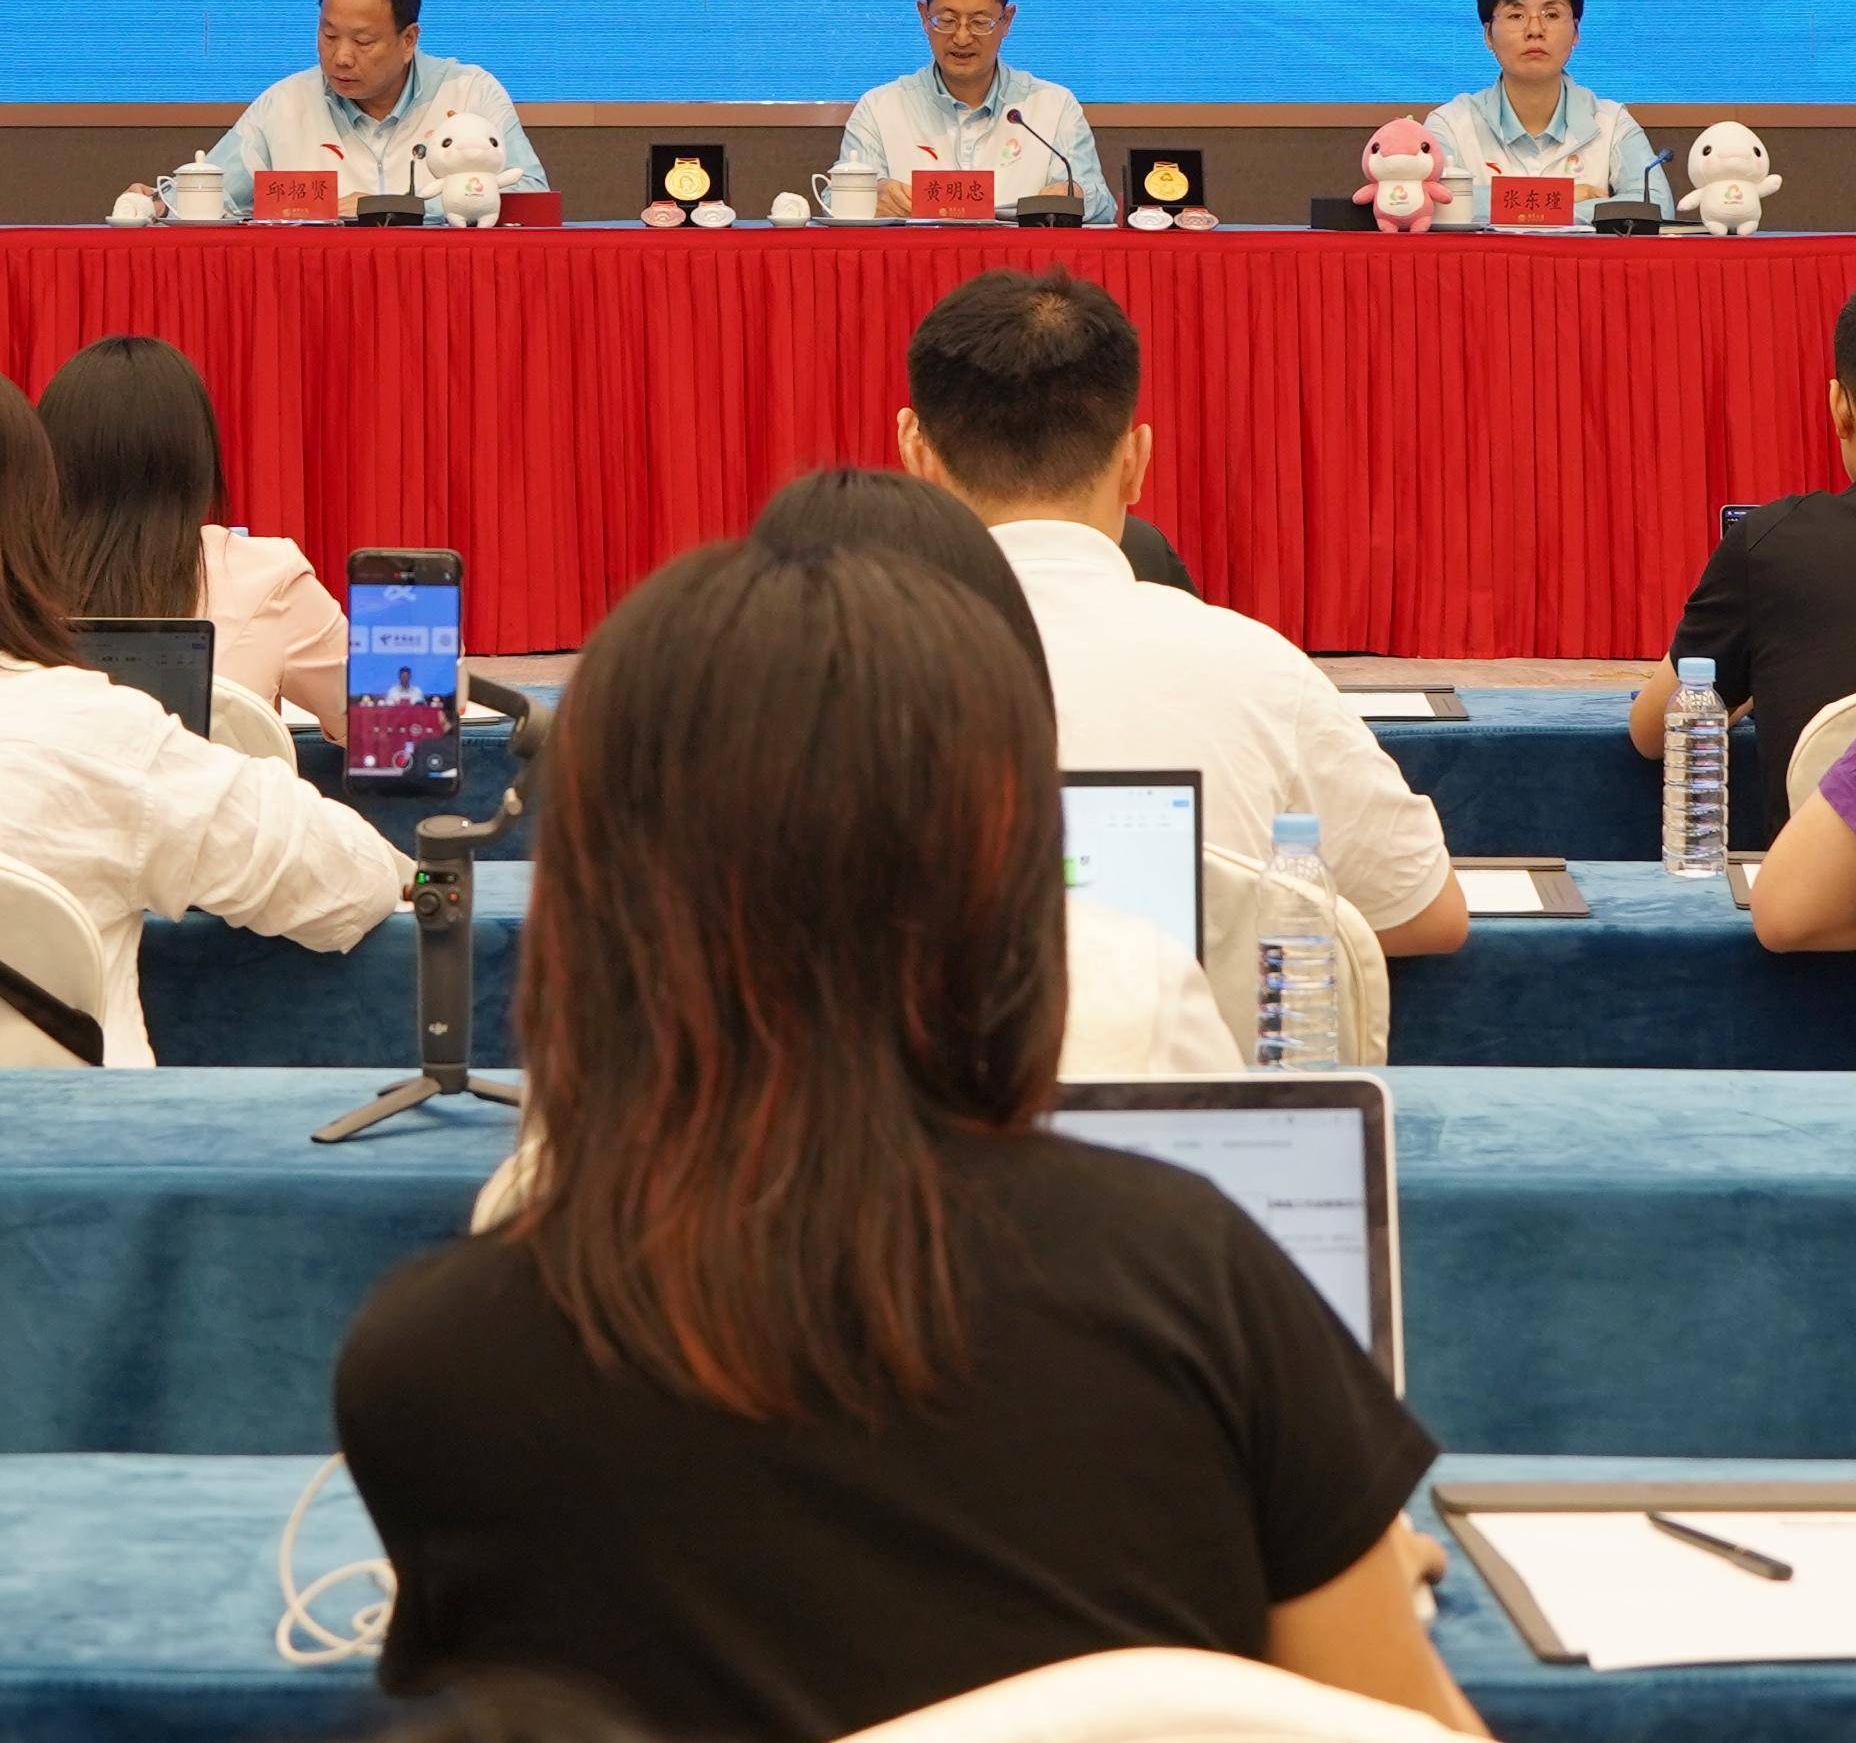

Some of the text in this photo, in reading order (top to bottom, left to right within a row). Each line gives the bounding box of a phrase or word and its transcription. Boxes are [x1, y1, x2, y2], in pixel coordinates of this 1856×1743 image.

[266, 179, 329, 203] 邱招贤
[924, 179, 985, 202] 黄明忠
